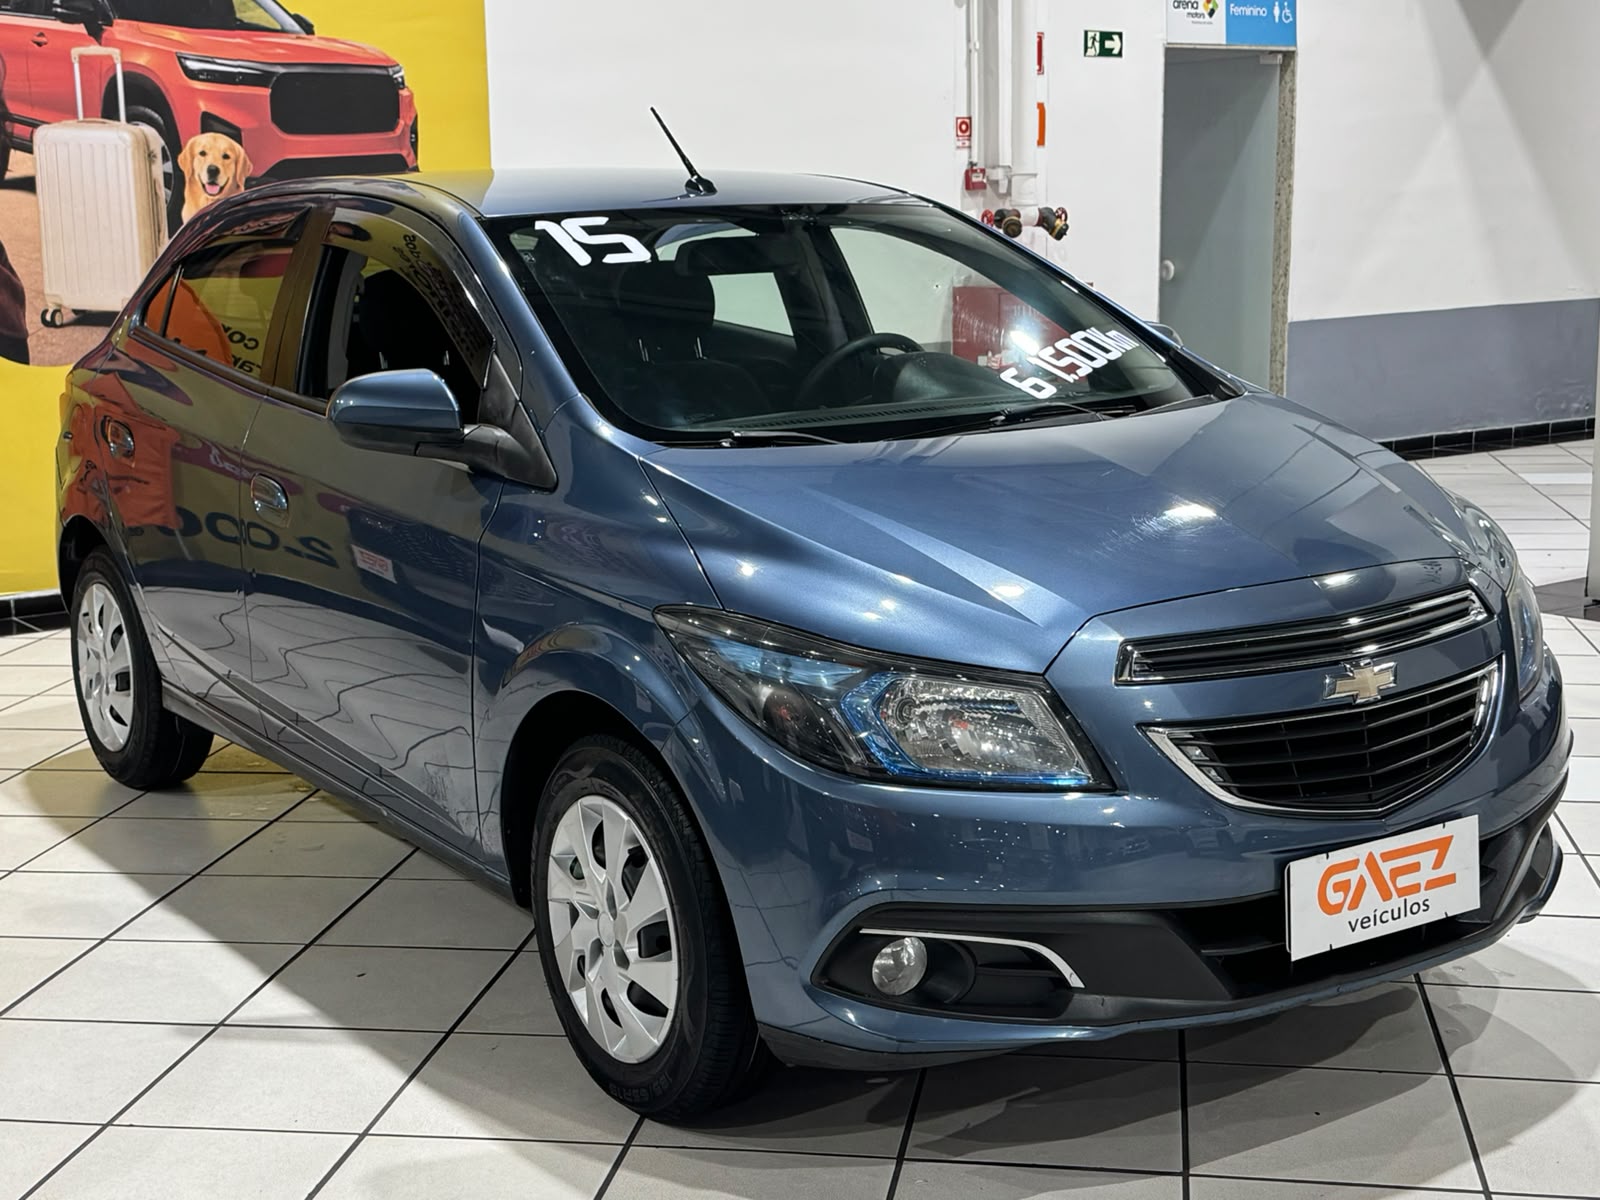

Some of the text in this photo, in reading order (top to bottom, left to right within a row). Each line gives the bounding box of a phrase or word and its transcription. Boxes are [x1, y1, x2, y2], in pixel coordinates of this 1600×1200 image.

[1229, 3, 1268, 17] Feminino
[534, 216, 652, 267] 15
[1317, 835, 1457, 916] GAEZ
[1348, 898, 1430, 933] veículos
